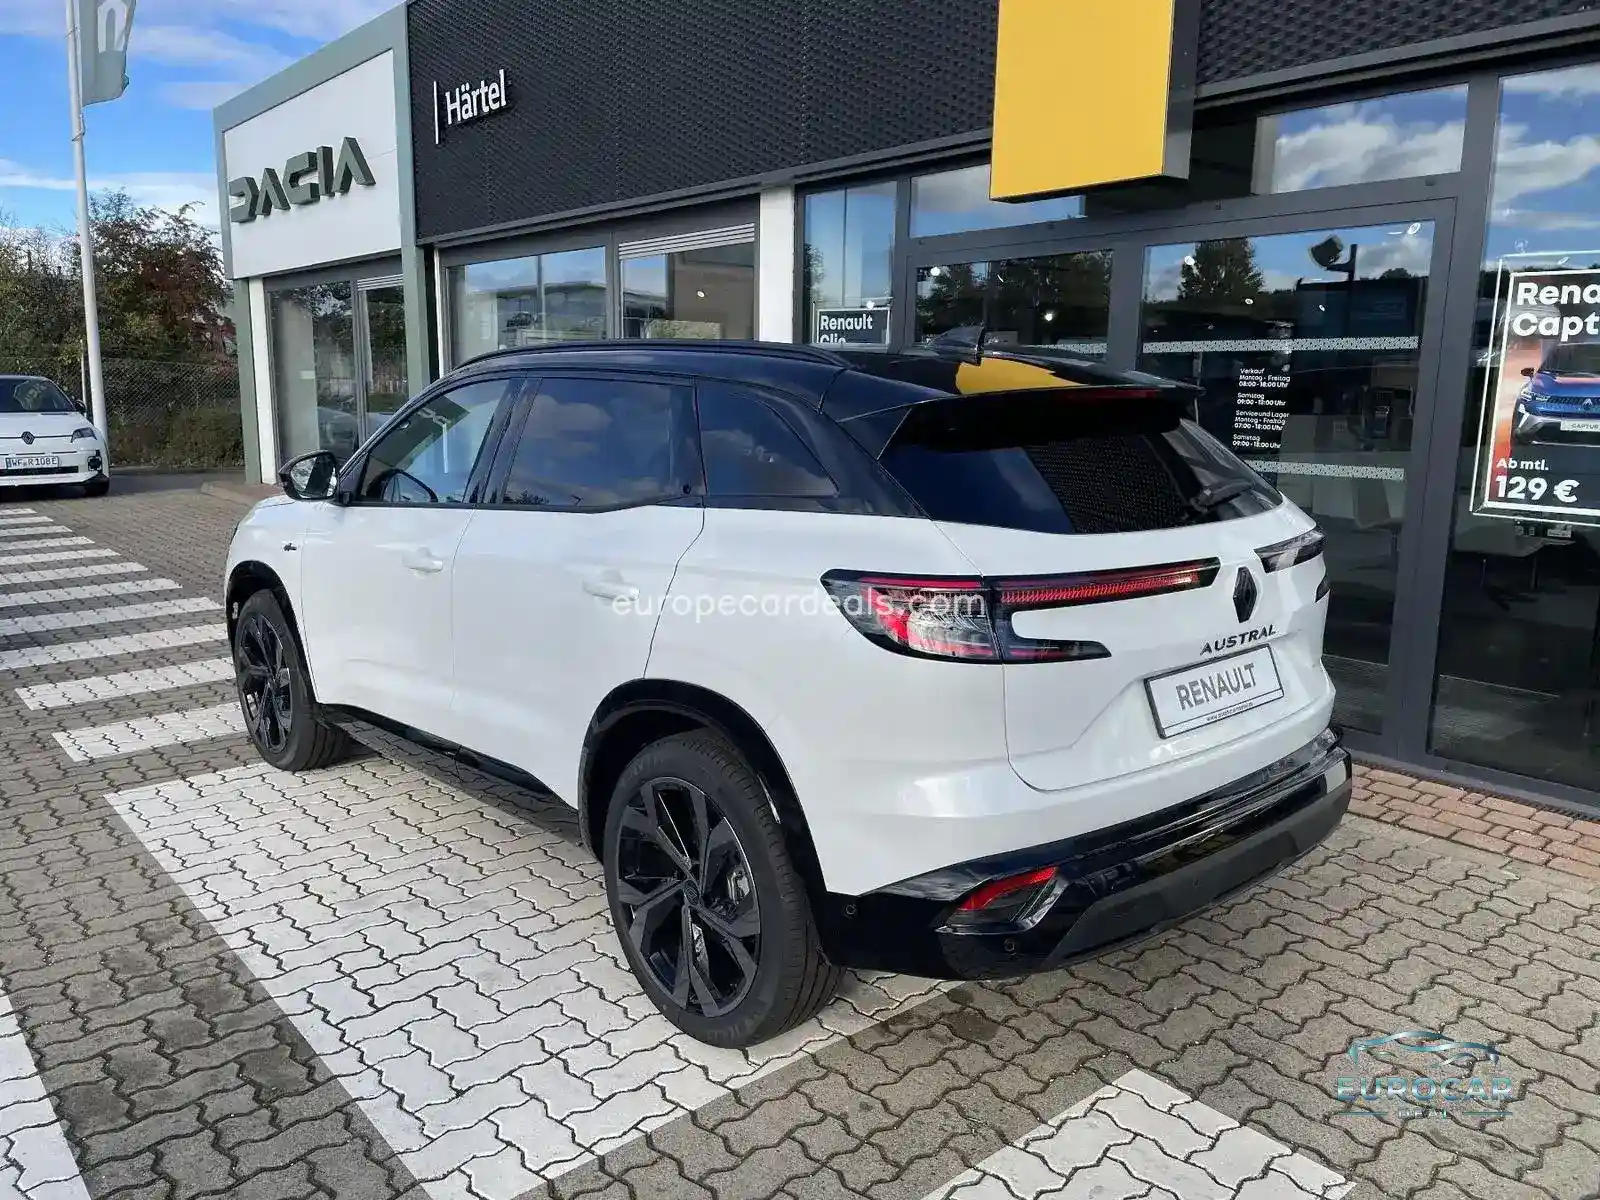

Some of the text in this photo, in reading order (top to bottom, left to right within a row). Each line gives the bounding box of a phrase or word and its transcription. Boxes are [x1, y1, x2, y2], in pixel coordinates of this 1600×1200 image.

[445, 69, 507, 125] Härtel
[229, 136, 376, 223] DACIA
[1517, 282, 1600, 305] Rena
[820, 314, 873, 330] Renault
[1513, 312, 1600, 342] Capt
[1263, 418, 1286, 426] Freitag
[1496, 457, 1549, 471] Ab mtl.
[1496, 475, 1580, 503] 129 €
[1200, 624, 1277, 655] AUSTRAL
[1175, 662, 1257, 711] RENAULT
